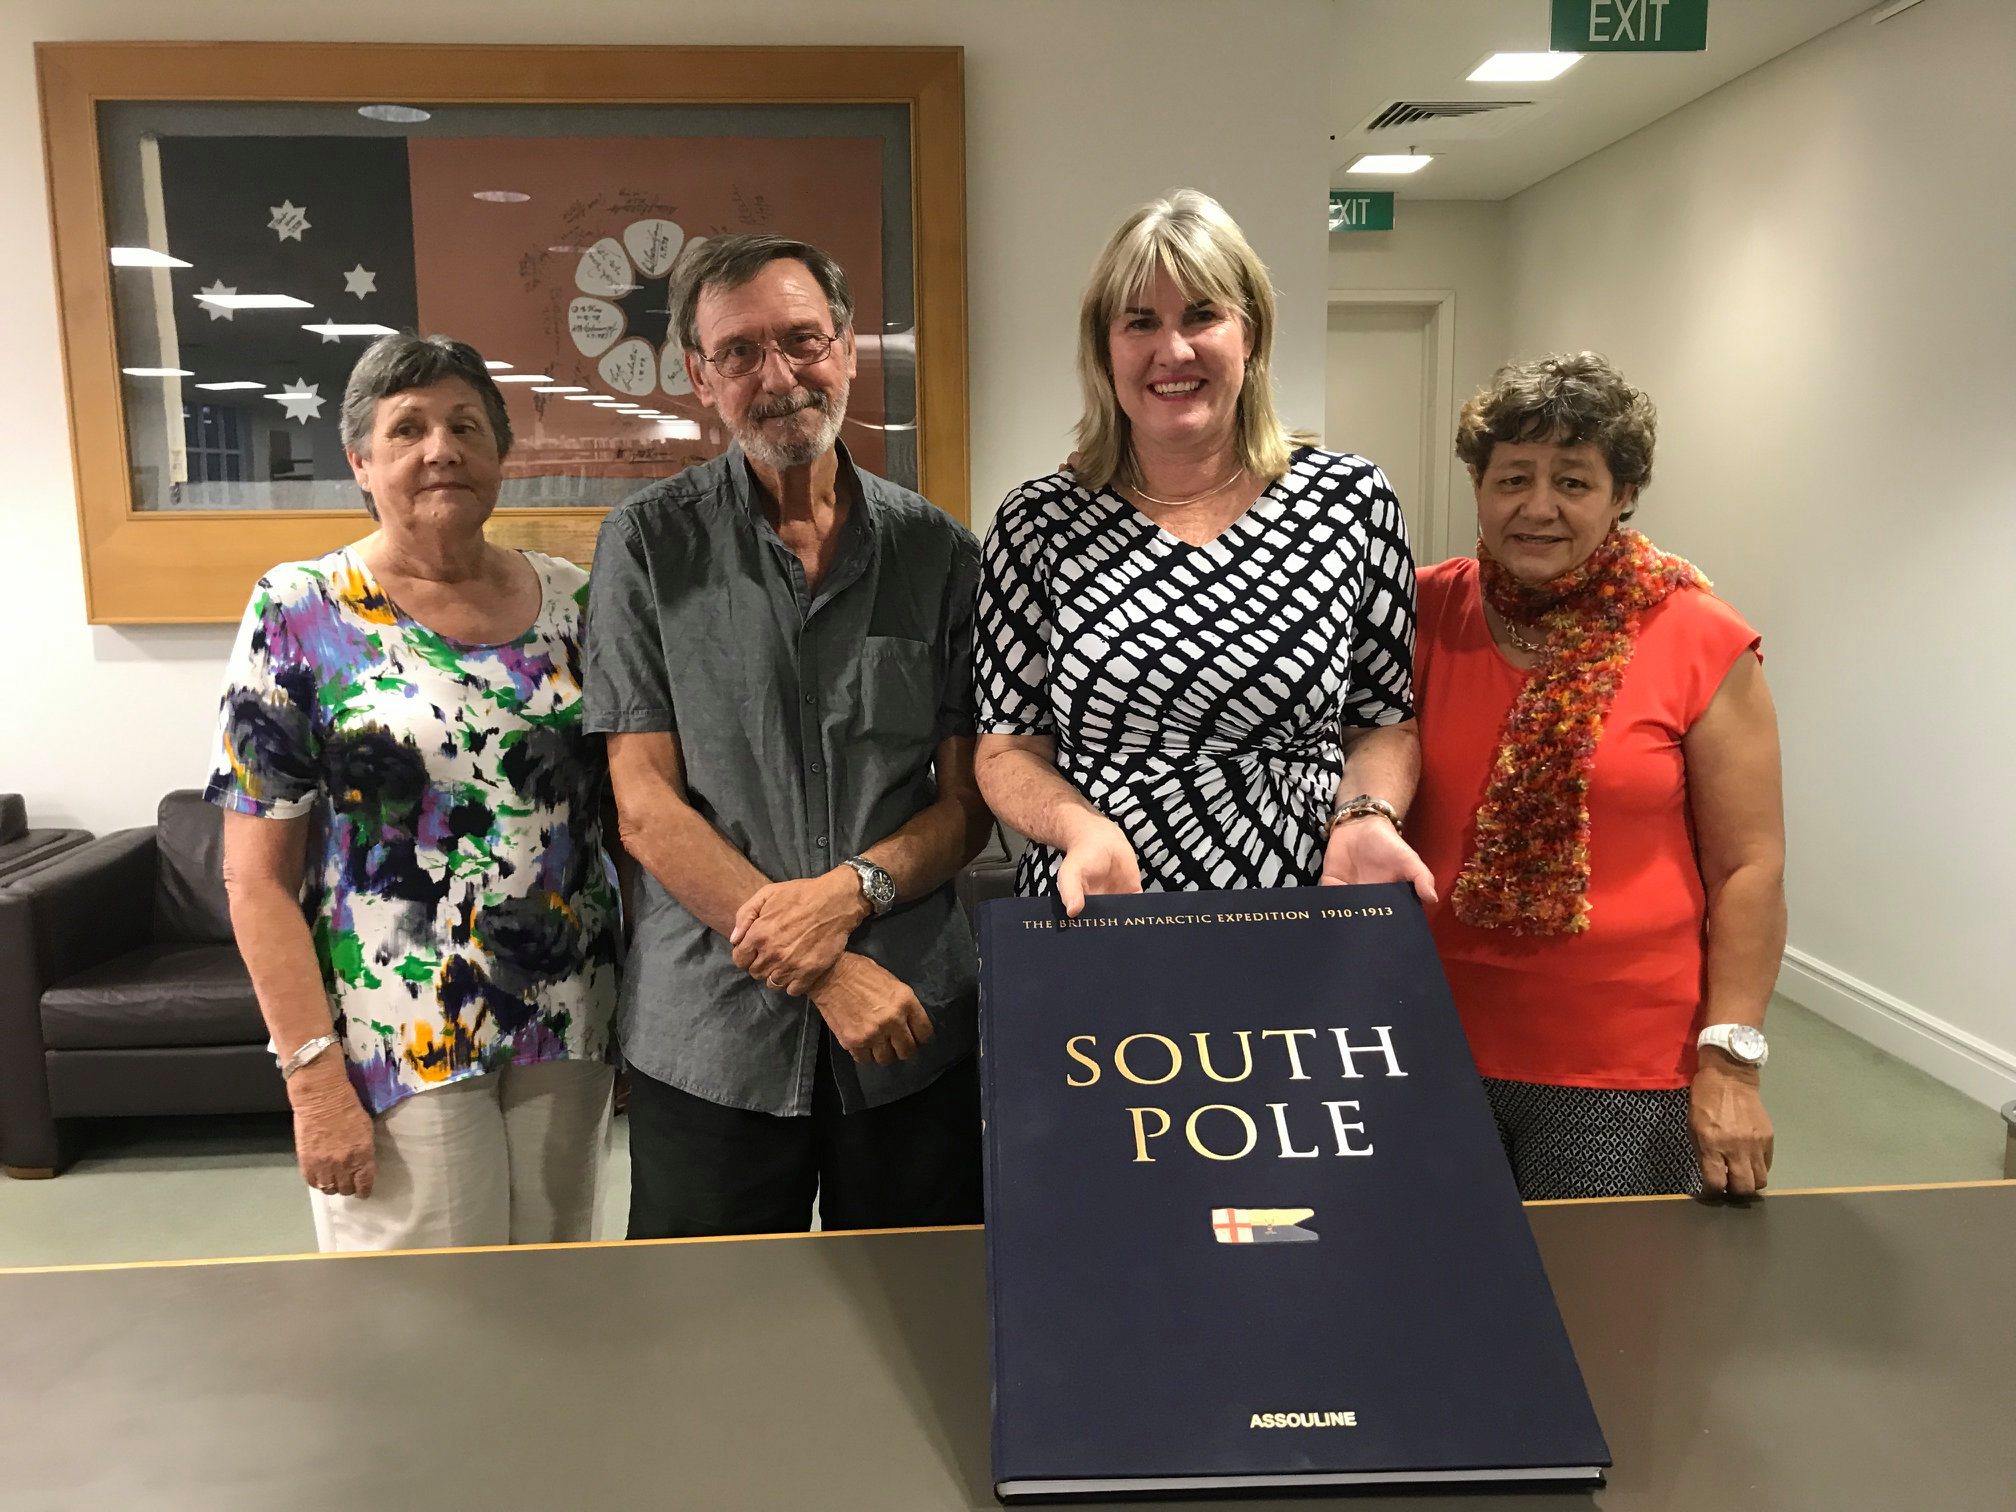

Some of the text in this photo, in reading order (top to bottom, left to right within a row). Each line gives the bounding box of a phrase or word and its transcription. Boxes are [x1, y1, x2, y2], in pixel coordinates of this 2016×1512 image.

[1589, 0, 1670, 42] EXIT
[1022, 920, 1053, 929] THE
[1058, 917, 1119, 928] BRITISH
[1124, 914, 1212, 926] ANTARCTIC
[1217, 911, 1310, 923] EXPEDITION
[1065, 1025, 1408, 1086] SOUTH
[1125, 1099, 1374, 1162] POLE
[1250, 1411, 1357, 1428] ASSOULINE
